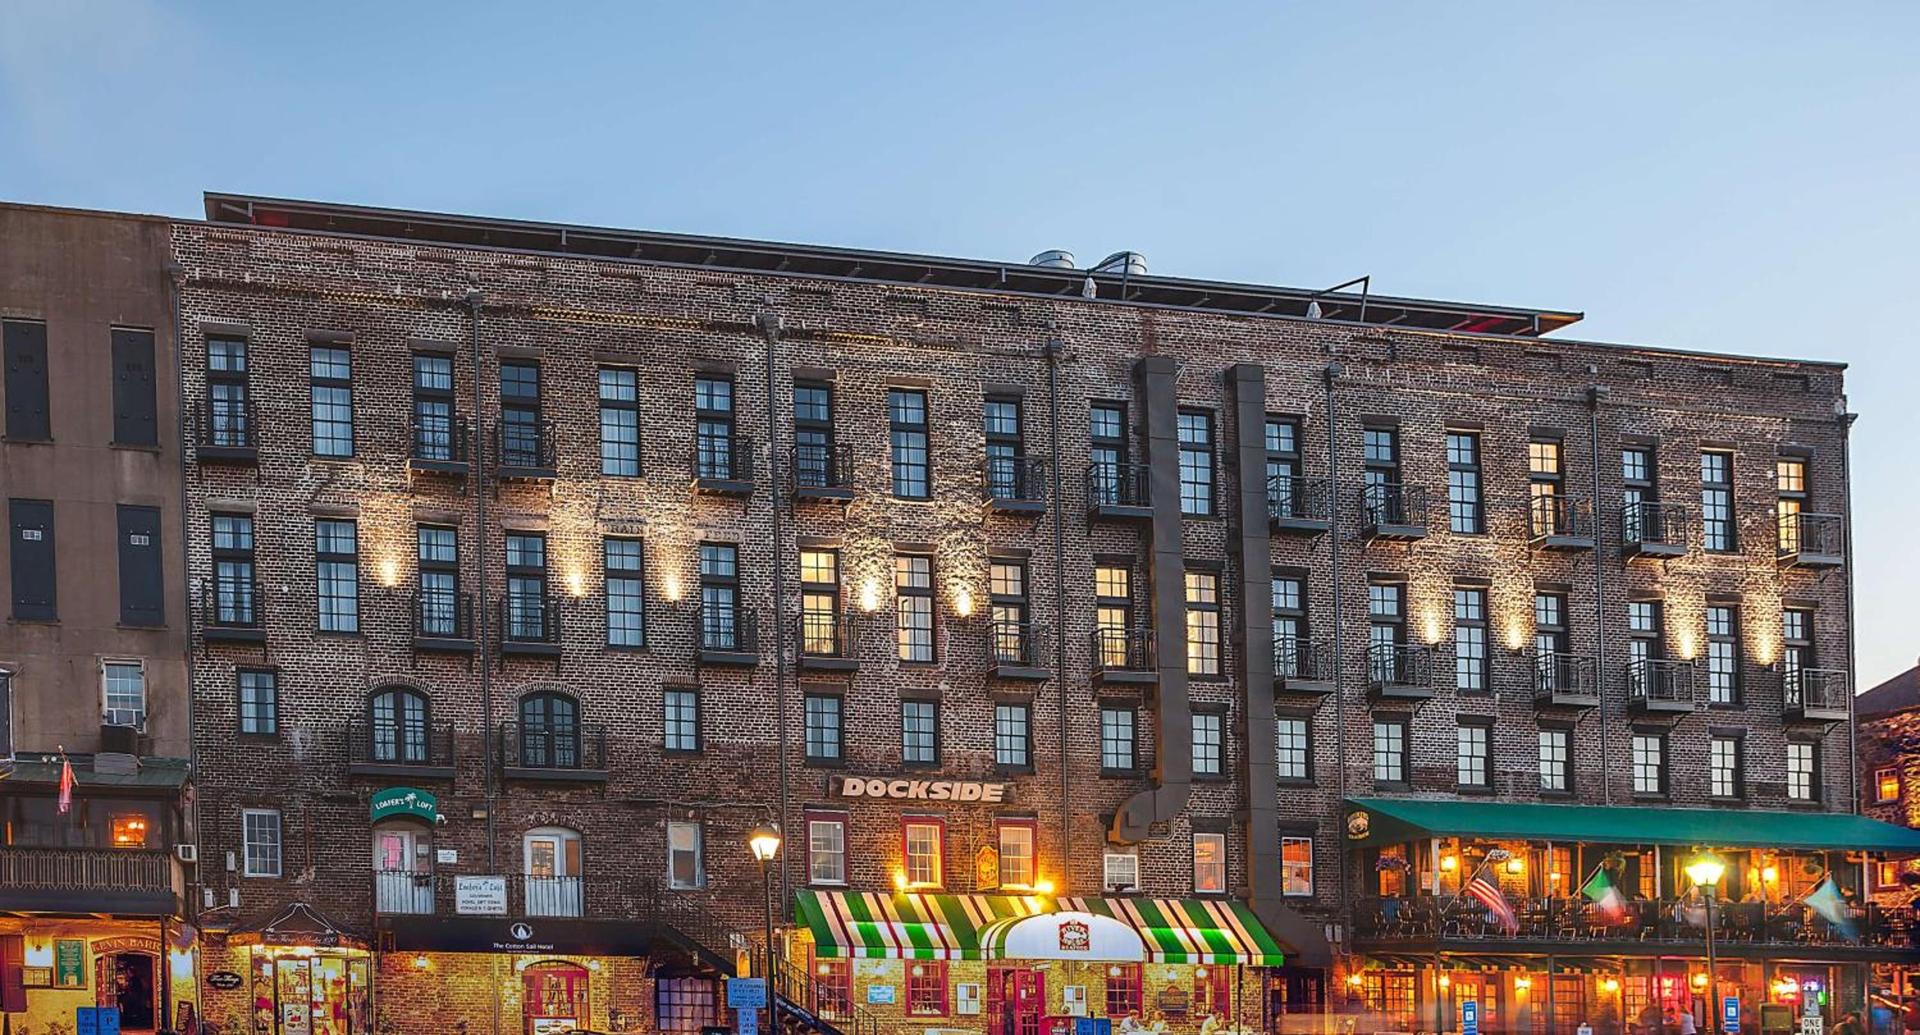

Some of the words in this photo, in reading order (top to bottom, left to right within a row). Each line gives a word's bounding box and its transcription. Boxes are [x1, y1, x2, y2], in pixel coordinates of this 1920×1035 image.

[842, 778, 1004, 802] DOCKSIDE
[416, 799, 433, 811] LOFT
[92, 939, 128, 952] KEVIN
[1804, 1018, 1821, 1028] ONE
